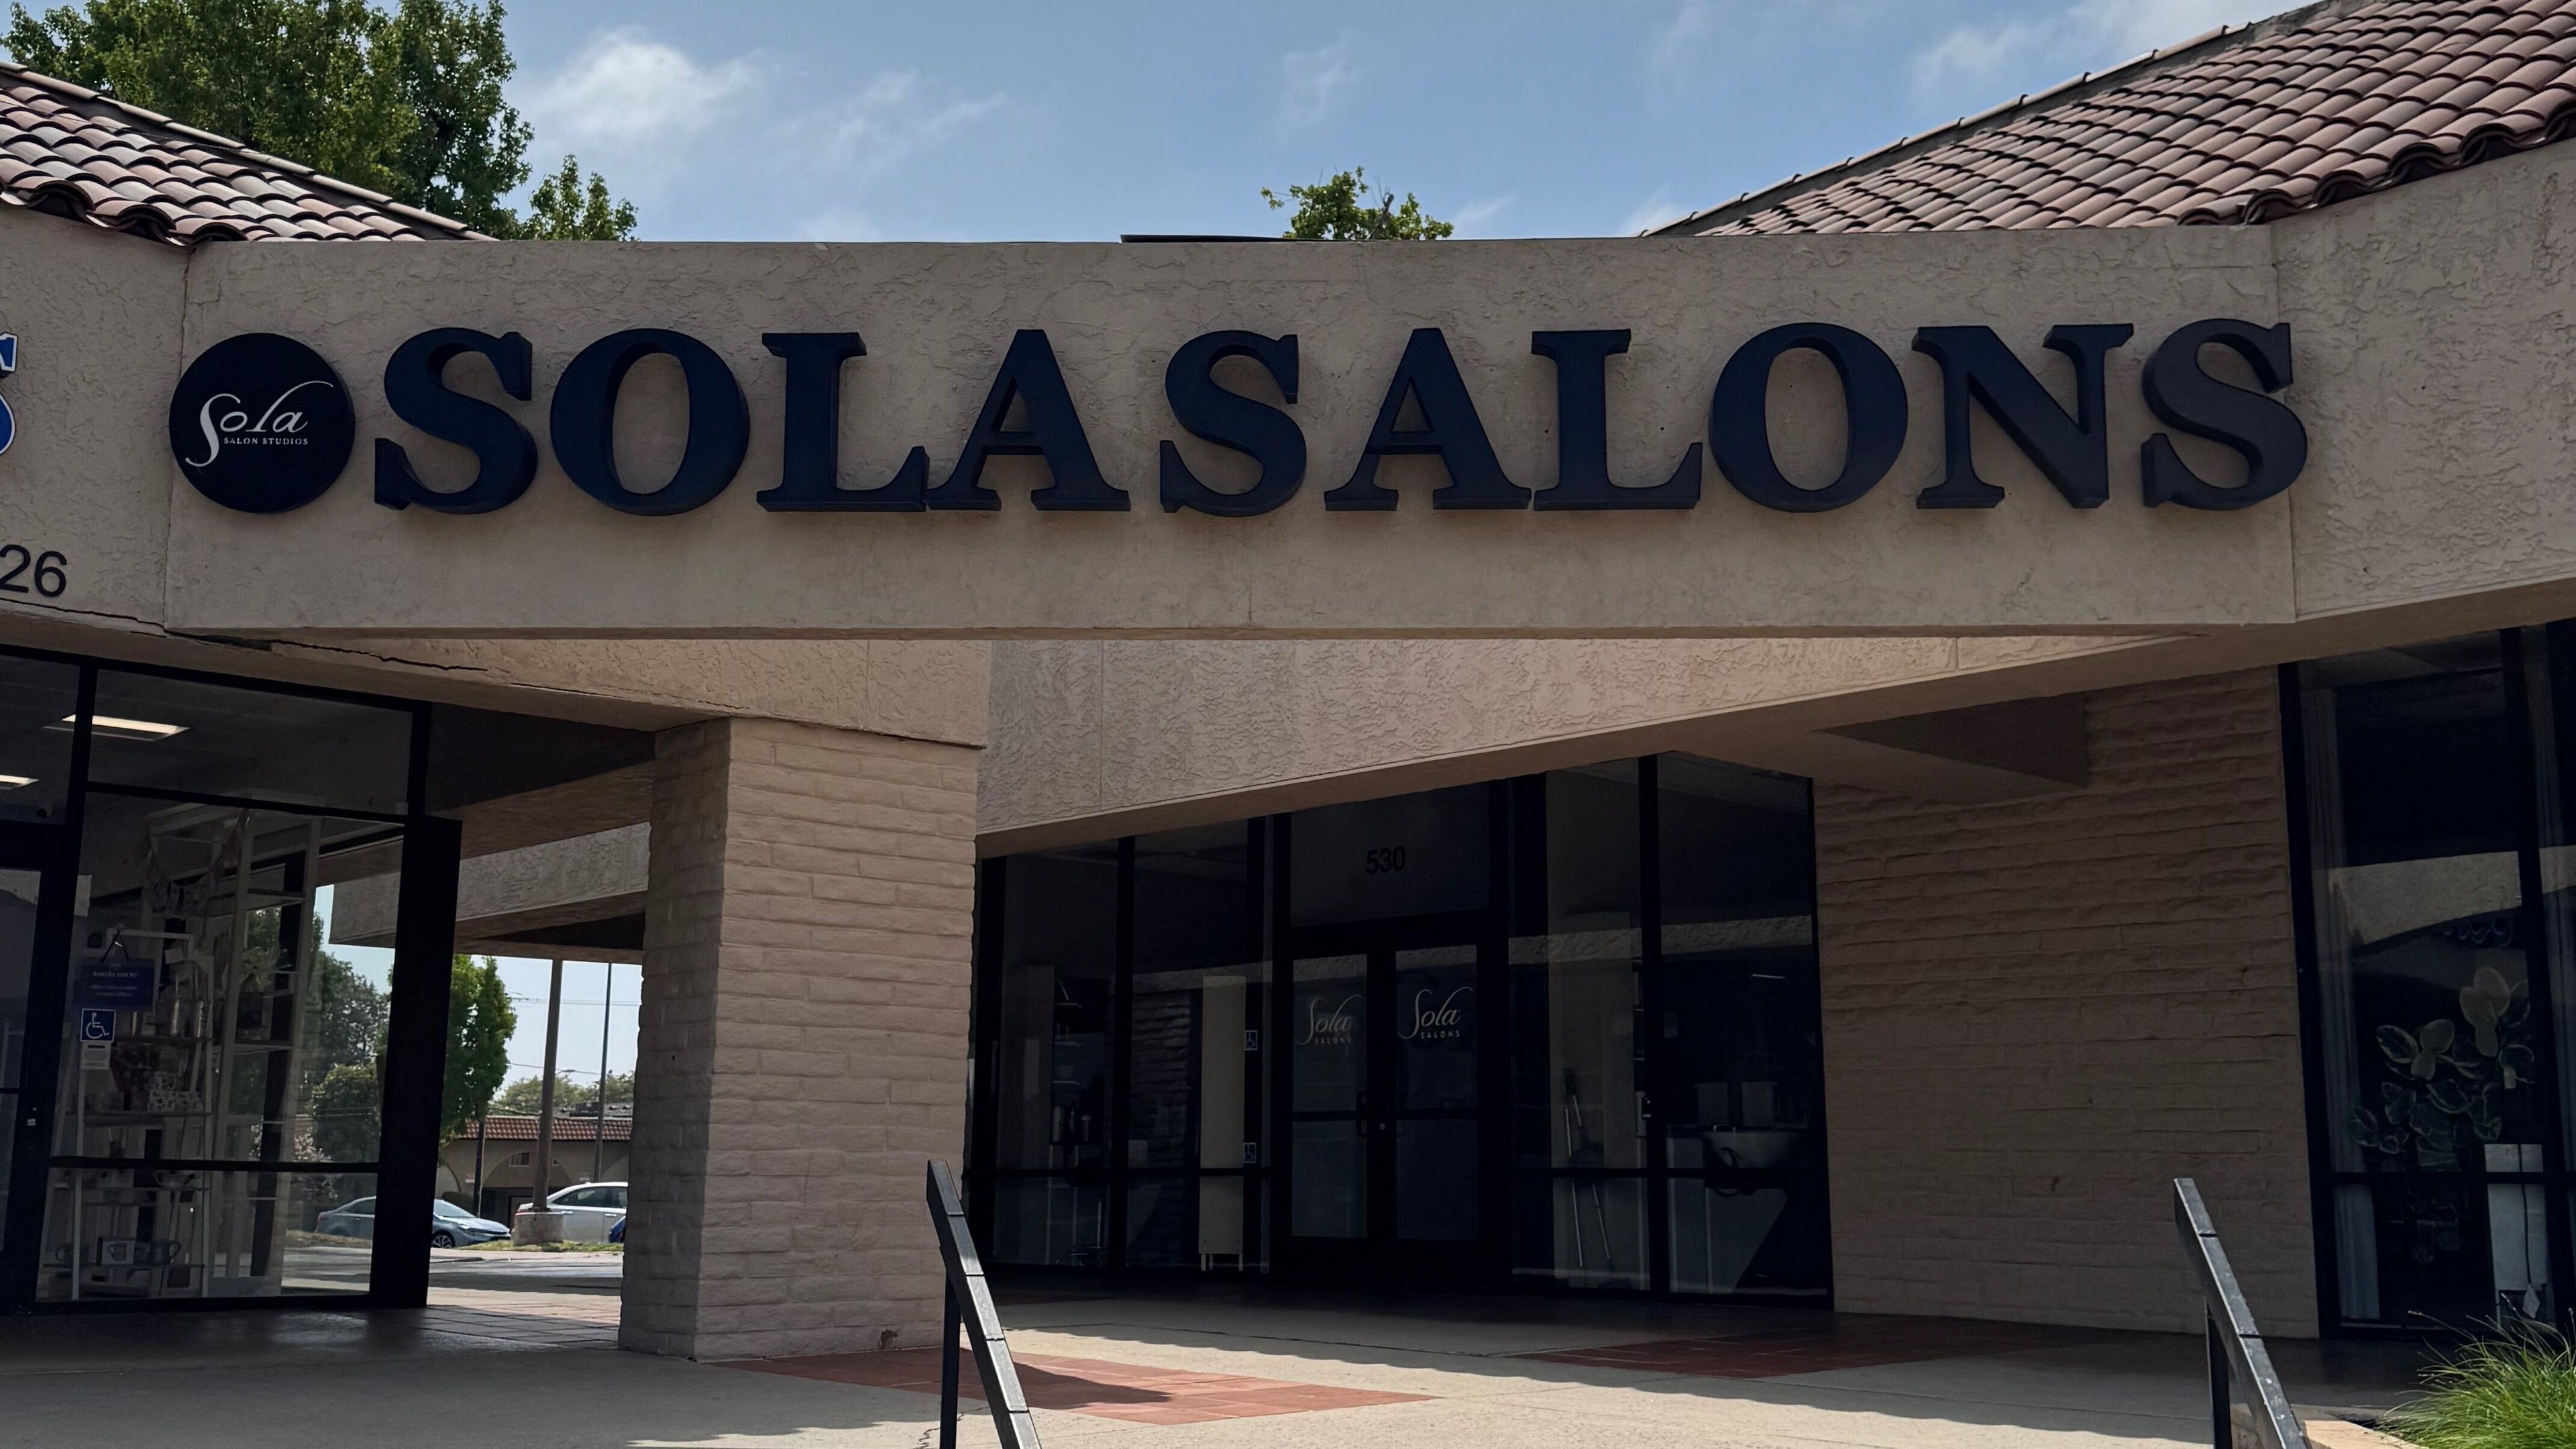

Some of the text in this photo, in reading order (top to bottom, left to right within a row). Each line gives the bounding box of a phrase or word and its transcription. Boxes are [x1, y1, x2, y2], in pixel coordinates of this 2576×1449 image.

[184, 380, 334, 468] Sola
[262, 437, 309, 445] STUDIOS
[1366, 846, 1405, 874] 530
[1295, 994, 1364, 1045] Sola
[1397, 986, 1473, 1040] Sola
[1420, 1030, 1460, 1040] SALONS
